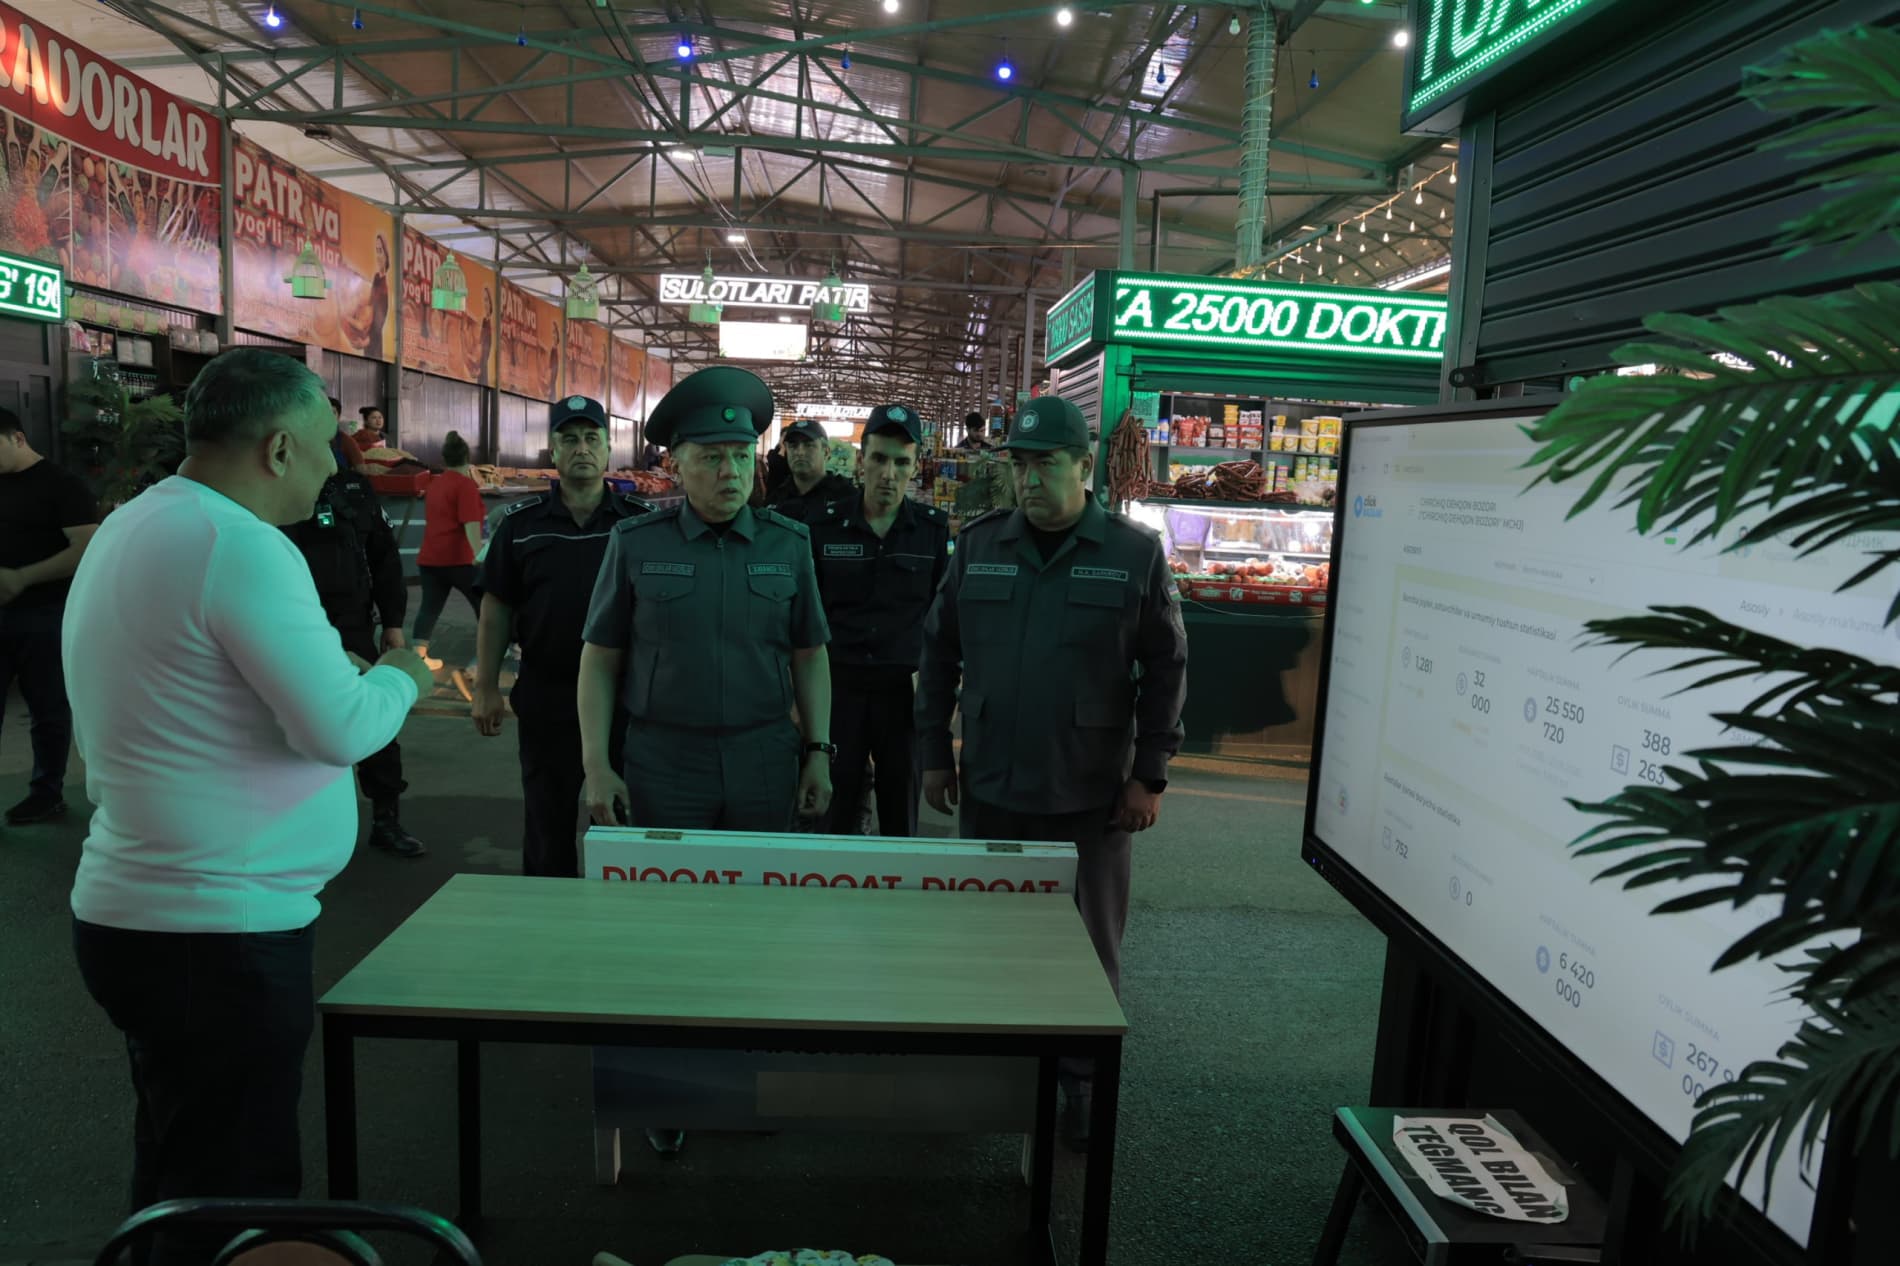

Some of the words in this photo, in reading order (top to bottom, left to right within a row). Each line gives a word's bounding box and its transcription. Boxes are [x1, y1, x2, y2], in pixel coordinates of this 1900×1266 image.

[235, 150, 304, 225] PATR
[310, 202, 338, 241] va
[296, 236, 340, 267] nnlar
[799, 286, 867, 308] PATIR
[1163, 293, 1300, 337] 25000
[1473, 670, 1486, 688] 32
[1471, 693, 1491, 715] 000
[1545, 695, 1561, 716] 25
[1561, 701, 1585, 724] 550
[1543, 722, 1565, 744] 720
[1641, 729, 1672, 756] 388
[1395, 839, 1409, 860] 752
[1465, 890, 1473, 907] 0
[1559, 951, 1568, 971] 6
[1570, 961, 1595, 990] 420
[1555, 977, 1582, 1010] 000
[1685, 1041, 1719, 1078] 267
[1447, 1123, 1504, 1156] QOL
[1482, 1160, 1563, 1219] BILAN
